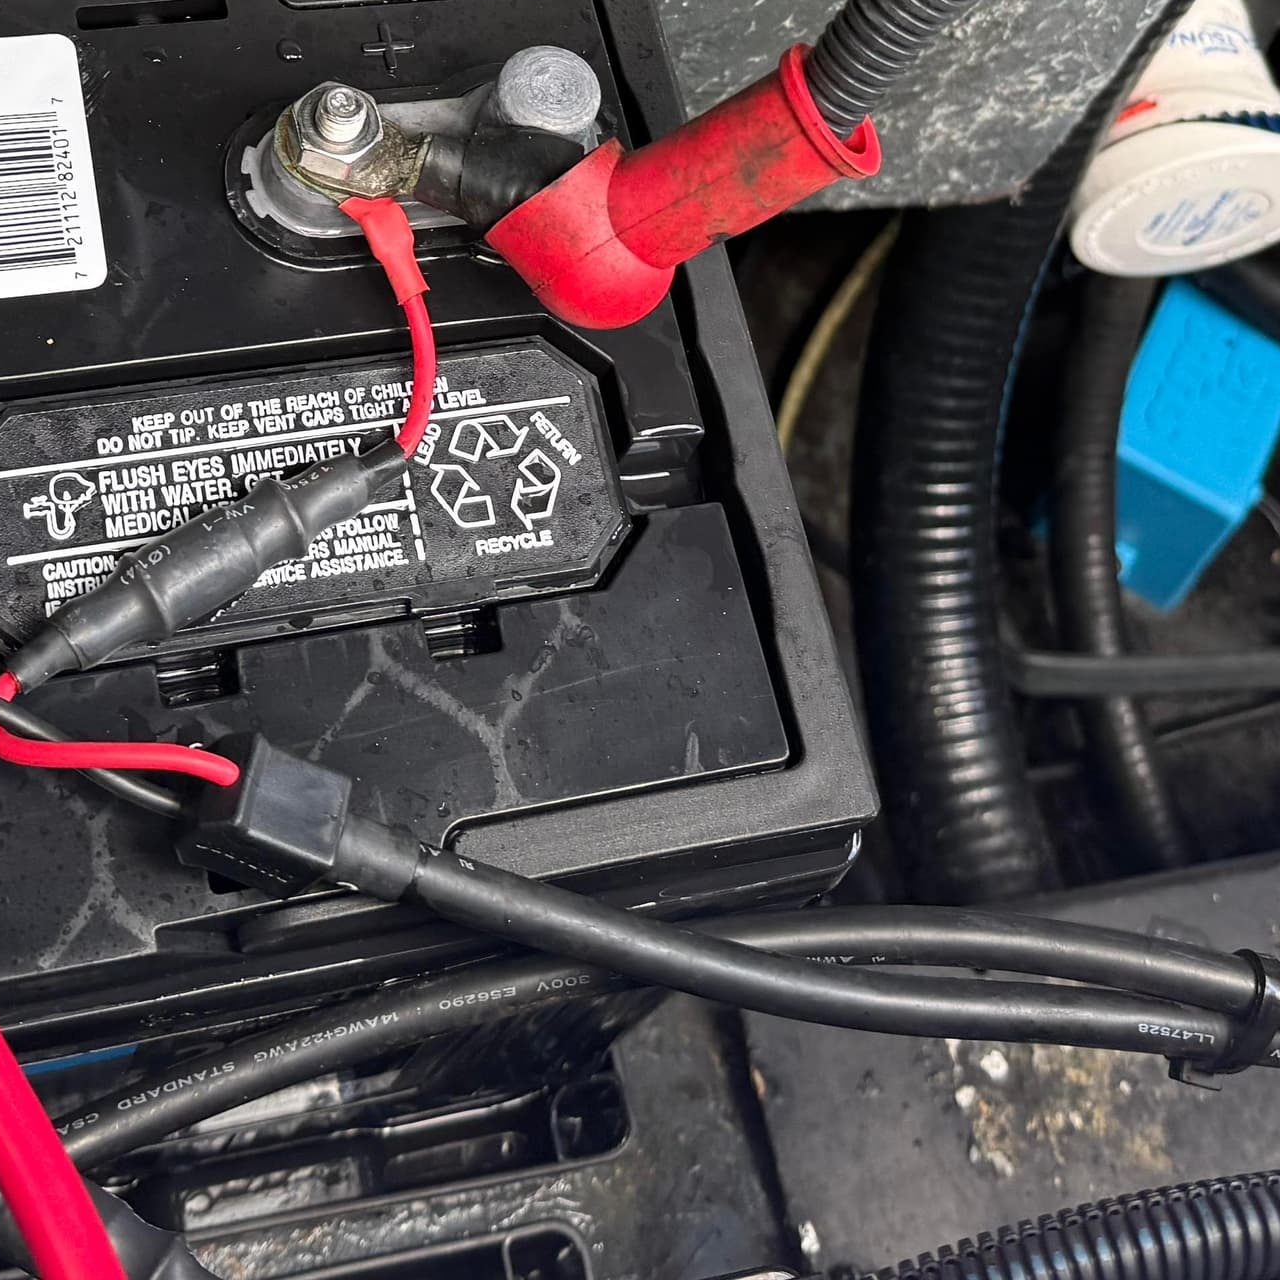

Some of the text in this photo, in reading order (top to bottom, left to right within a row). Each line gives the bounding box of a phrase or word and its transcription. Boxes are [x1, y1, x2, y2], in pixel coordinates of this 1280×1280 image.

[51, 97, 88, 280] 7 21112 82401 7
[132, 376, 449, 434] KEEP OUT OF THE REACH OF CHILDN
[96, 436, 124, 455] DO
[127, 431, 164, 452] NOT
[168, 426, 201, 445] TIP.
[207, 420, 250, 440] KEEP
[253, 413, 297, 435] VENT
[302, 407, 345, 427] CAPS
[349, 400, 395, 421] TIGHT
[414, 423, 442, 466] LEAD
[529, 411, 583, 466] RETURN
[98, 464, 166, 493] FLUSH
[171, 456, 225, 481] EYES
[101, 489, 157, 515] WITH
[161, 478, 238, 507] WATER.
[105, 507, 191, 538] MEDICAL
[202, 503, 256, 532] VW-1
[336, 513, 400, 538] FOLLOW
[475, 529, 554, 556] RECYCLE
[253, 563, 307, 588] RVICE
[310, 549, 410, 579] ASSISTANCE.
[439, 985, 516, 1011] E56290
[536, 974, 591, 993] 300V
[253, 1011, 400, 1062] 14AWG+22AWG
[1138, 1022, 1215, 1046] LL47528
[117, 1060, 236, 1111] STANDARD
